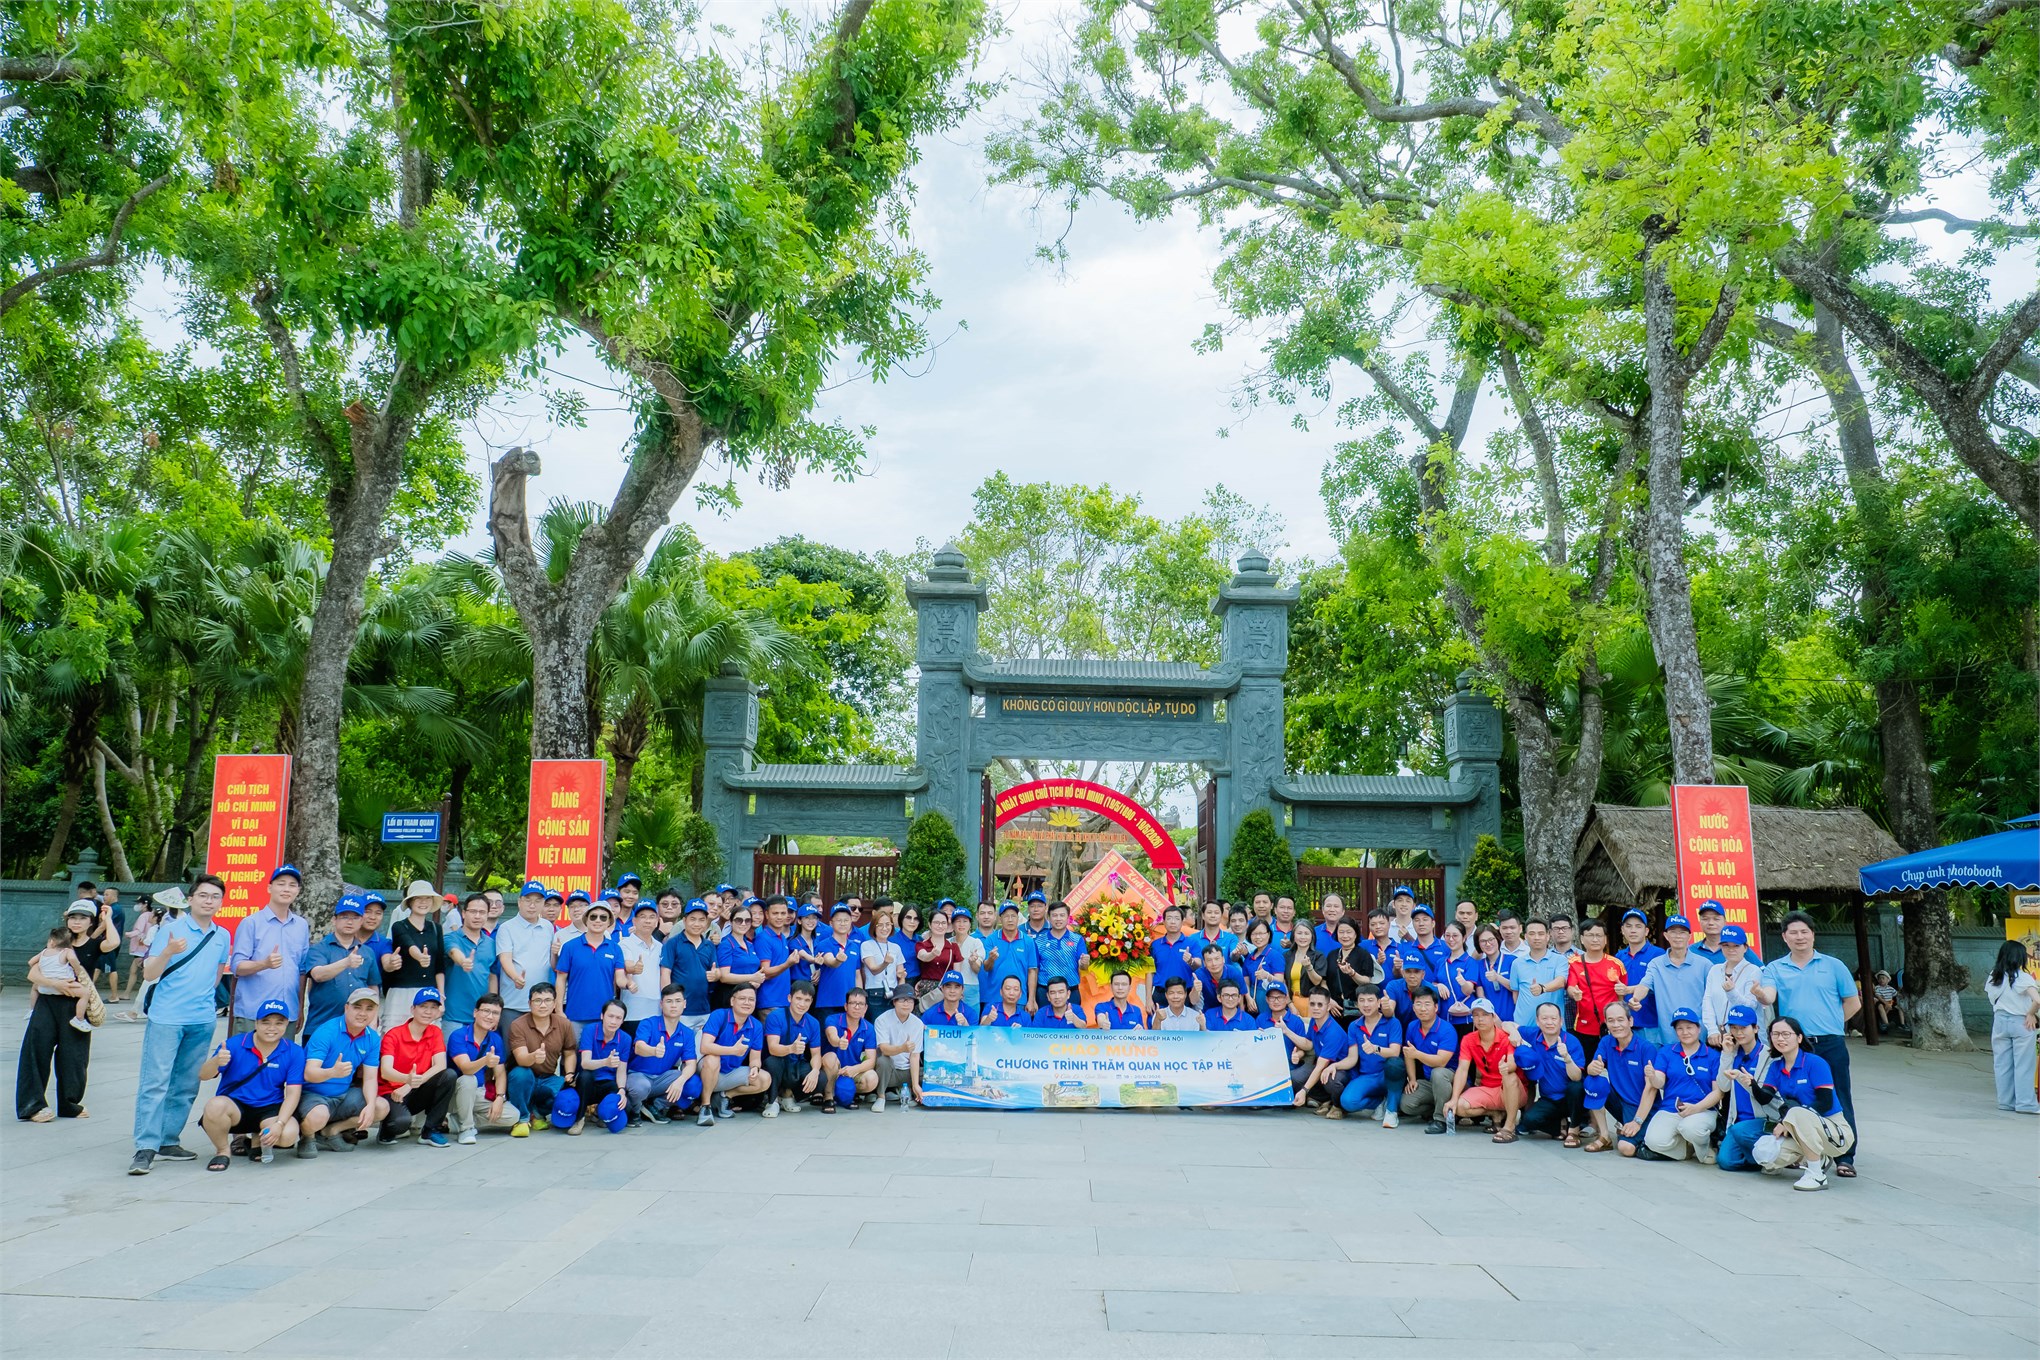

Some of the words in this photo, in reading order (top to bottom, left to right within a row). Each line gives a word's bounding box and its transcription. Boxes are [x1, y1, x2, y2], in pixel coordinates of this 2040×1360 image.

[1003, 696, 1039, 711] KHÔNG
[1041, 696, 1056, 711] CÓ
[1057, 696, 1068, 711] GÌ
[1069, 697, 1092, 712] QUÝ
[1093, 701, 1116, 713] HƠN
[1117, 698, 1139, 717] ĐỘC
[1141, 698, 1164, 717] LẬP,
[1165, 702, 1179, 718] TỰ
[1180, 703, 1196, 714] DO
[227, 781, 247, 795] CHỦ
[249, 784, 269, 797] TỊCH
[217, 799, 231, 812] HỒ
[232, 799, 249, 812] CHÍ
[250, 801, 276, 812] MINH
[551, 786, 580, 809] ĐẢNG
[1000, 795, 1019, 812] NGÀY
[1018, 790, 1035, 805] SINH
[1035, 784, 1049, 800] CHỦ
[1049, 786, 1064, 800] TỊCH
[1064, 783, 1074, 798] HỒ
[1074, 786, 1087, 800] CHÍ
[1086, 789, 1105, 805] MINH
[231, 818, 241, 830] VĨ
[242, 819, 259, 831] ĐẠI
[538, 816, 566, 839] CỘNG
[568, 814, 590, 836] SẢN
[1699, 812, 1729, 829] NƯỚC
[220, 833, 246, 847] SỐNG
[248, 835, 267, 847] MÃI
[1689, 835, 1719, 855] CỘNG
[1721, 835, 1743, 853] HÒA
[226, 854, 257, 865] TRONG
[538, 844, 560, 868] VIỆT
[562, 847, 587, 864] NAM
[230, 869, 265, 884] NGHIỆP
[1700, 860, 1715, 876] XÃ
[1717, 860, 1736, 879] HỘI
[1901, 869, 1925, 882] Chụp
[567, 875, 591, 893] VINH
[1690, 880, 1714, 899] CHỦ
[1715, 882, 1749, 899] NGHĨA
[229, 886, 249, 900] CỦA
[215, 904, 247, 918] CHÚNG
[938, 1030, 962, 1039] HaUI
[1253, 1034, 1276, 1043] Ntrip
[995, 1058, 1049, 1070] CHƯƠNG
[1053, 1057, 1088, 1070] TRÌNH
[1092, 1059, 1125, 1071] THĂM
[1128, 1061, 1160, 1071] QUAN
[1163, 1061, 1188, 1073] HỌC
[1192, 1058, 1213, 1073] TẬP
[1217, 1058, 1233, 1070] HÈ
